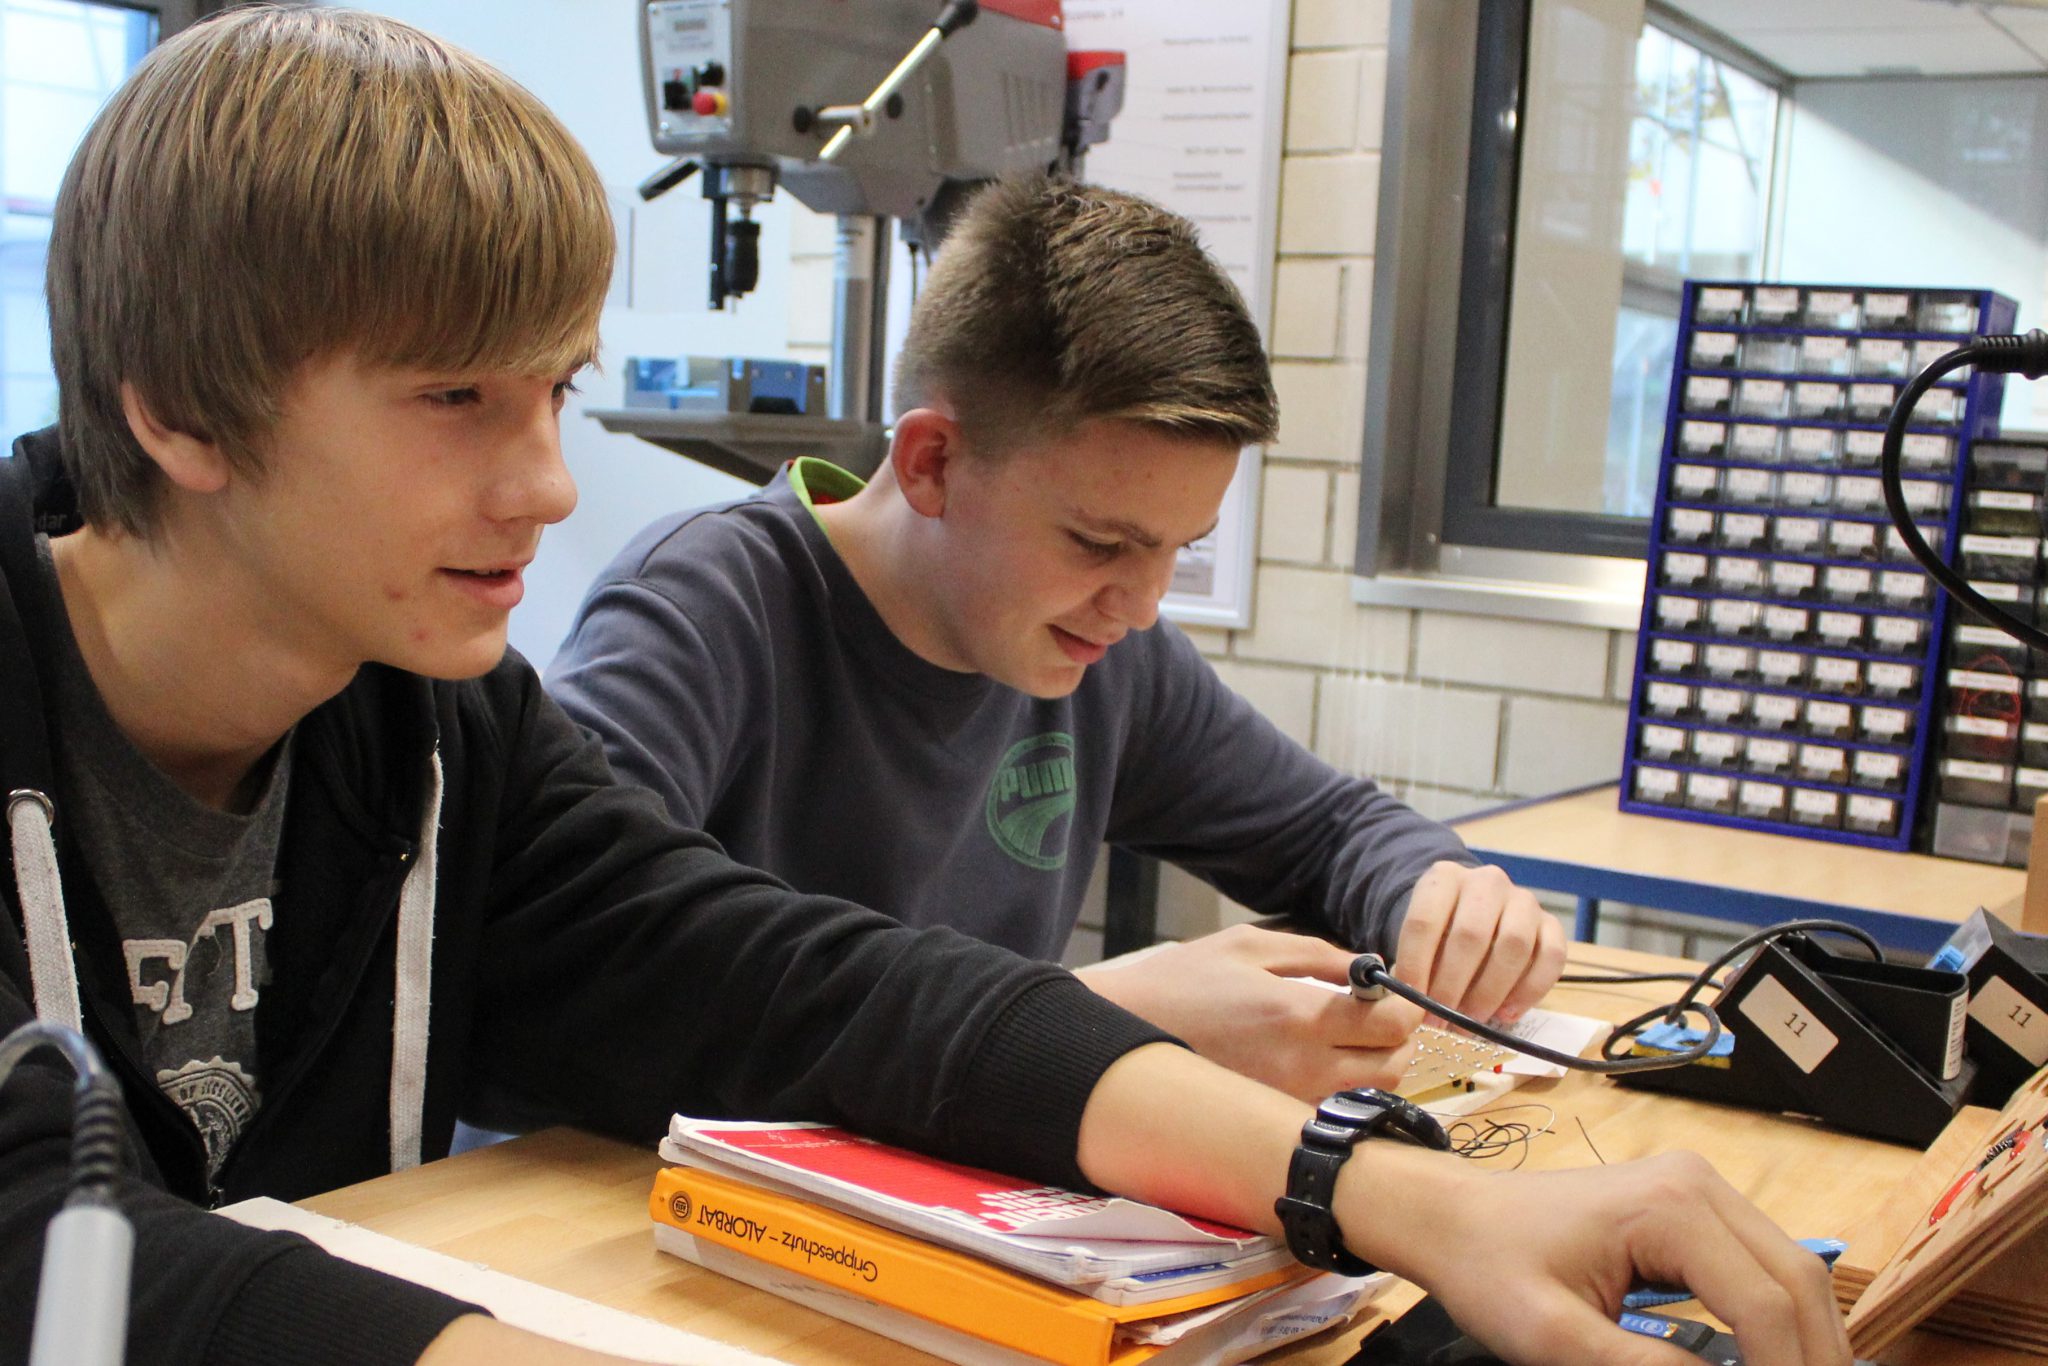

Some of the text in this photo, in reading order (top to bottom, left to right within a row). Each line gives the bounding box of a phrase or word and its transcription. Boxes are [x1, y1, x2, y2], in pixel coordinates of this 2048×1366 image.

[1784, 1012, 1807, 1038] 11
[2008, 1005, 2032, 1029] 11
[697, 1204, 768, 1243] ALORBAT
[772, 1231, 878, 1282] Grippeschutz
